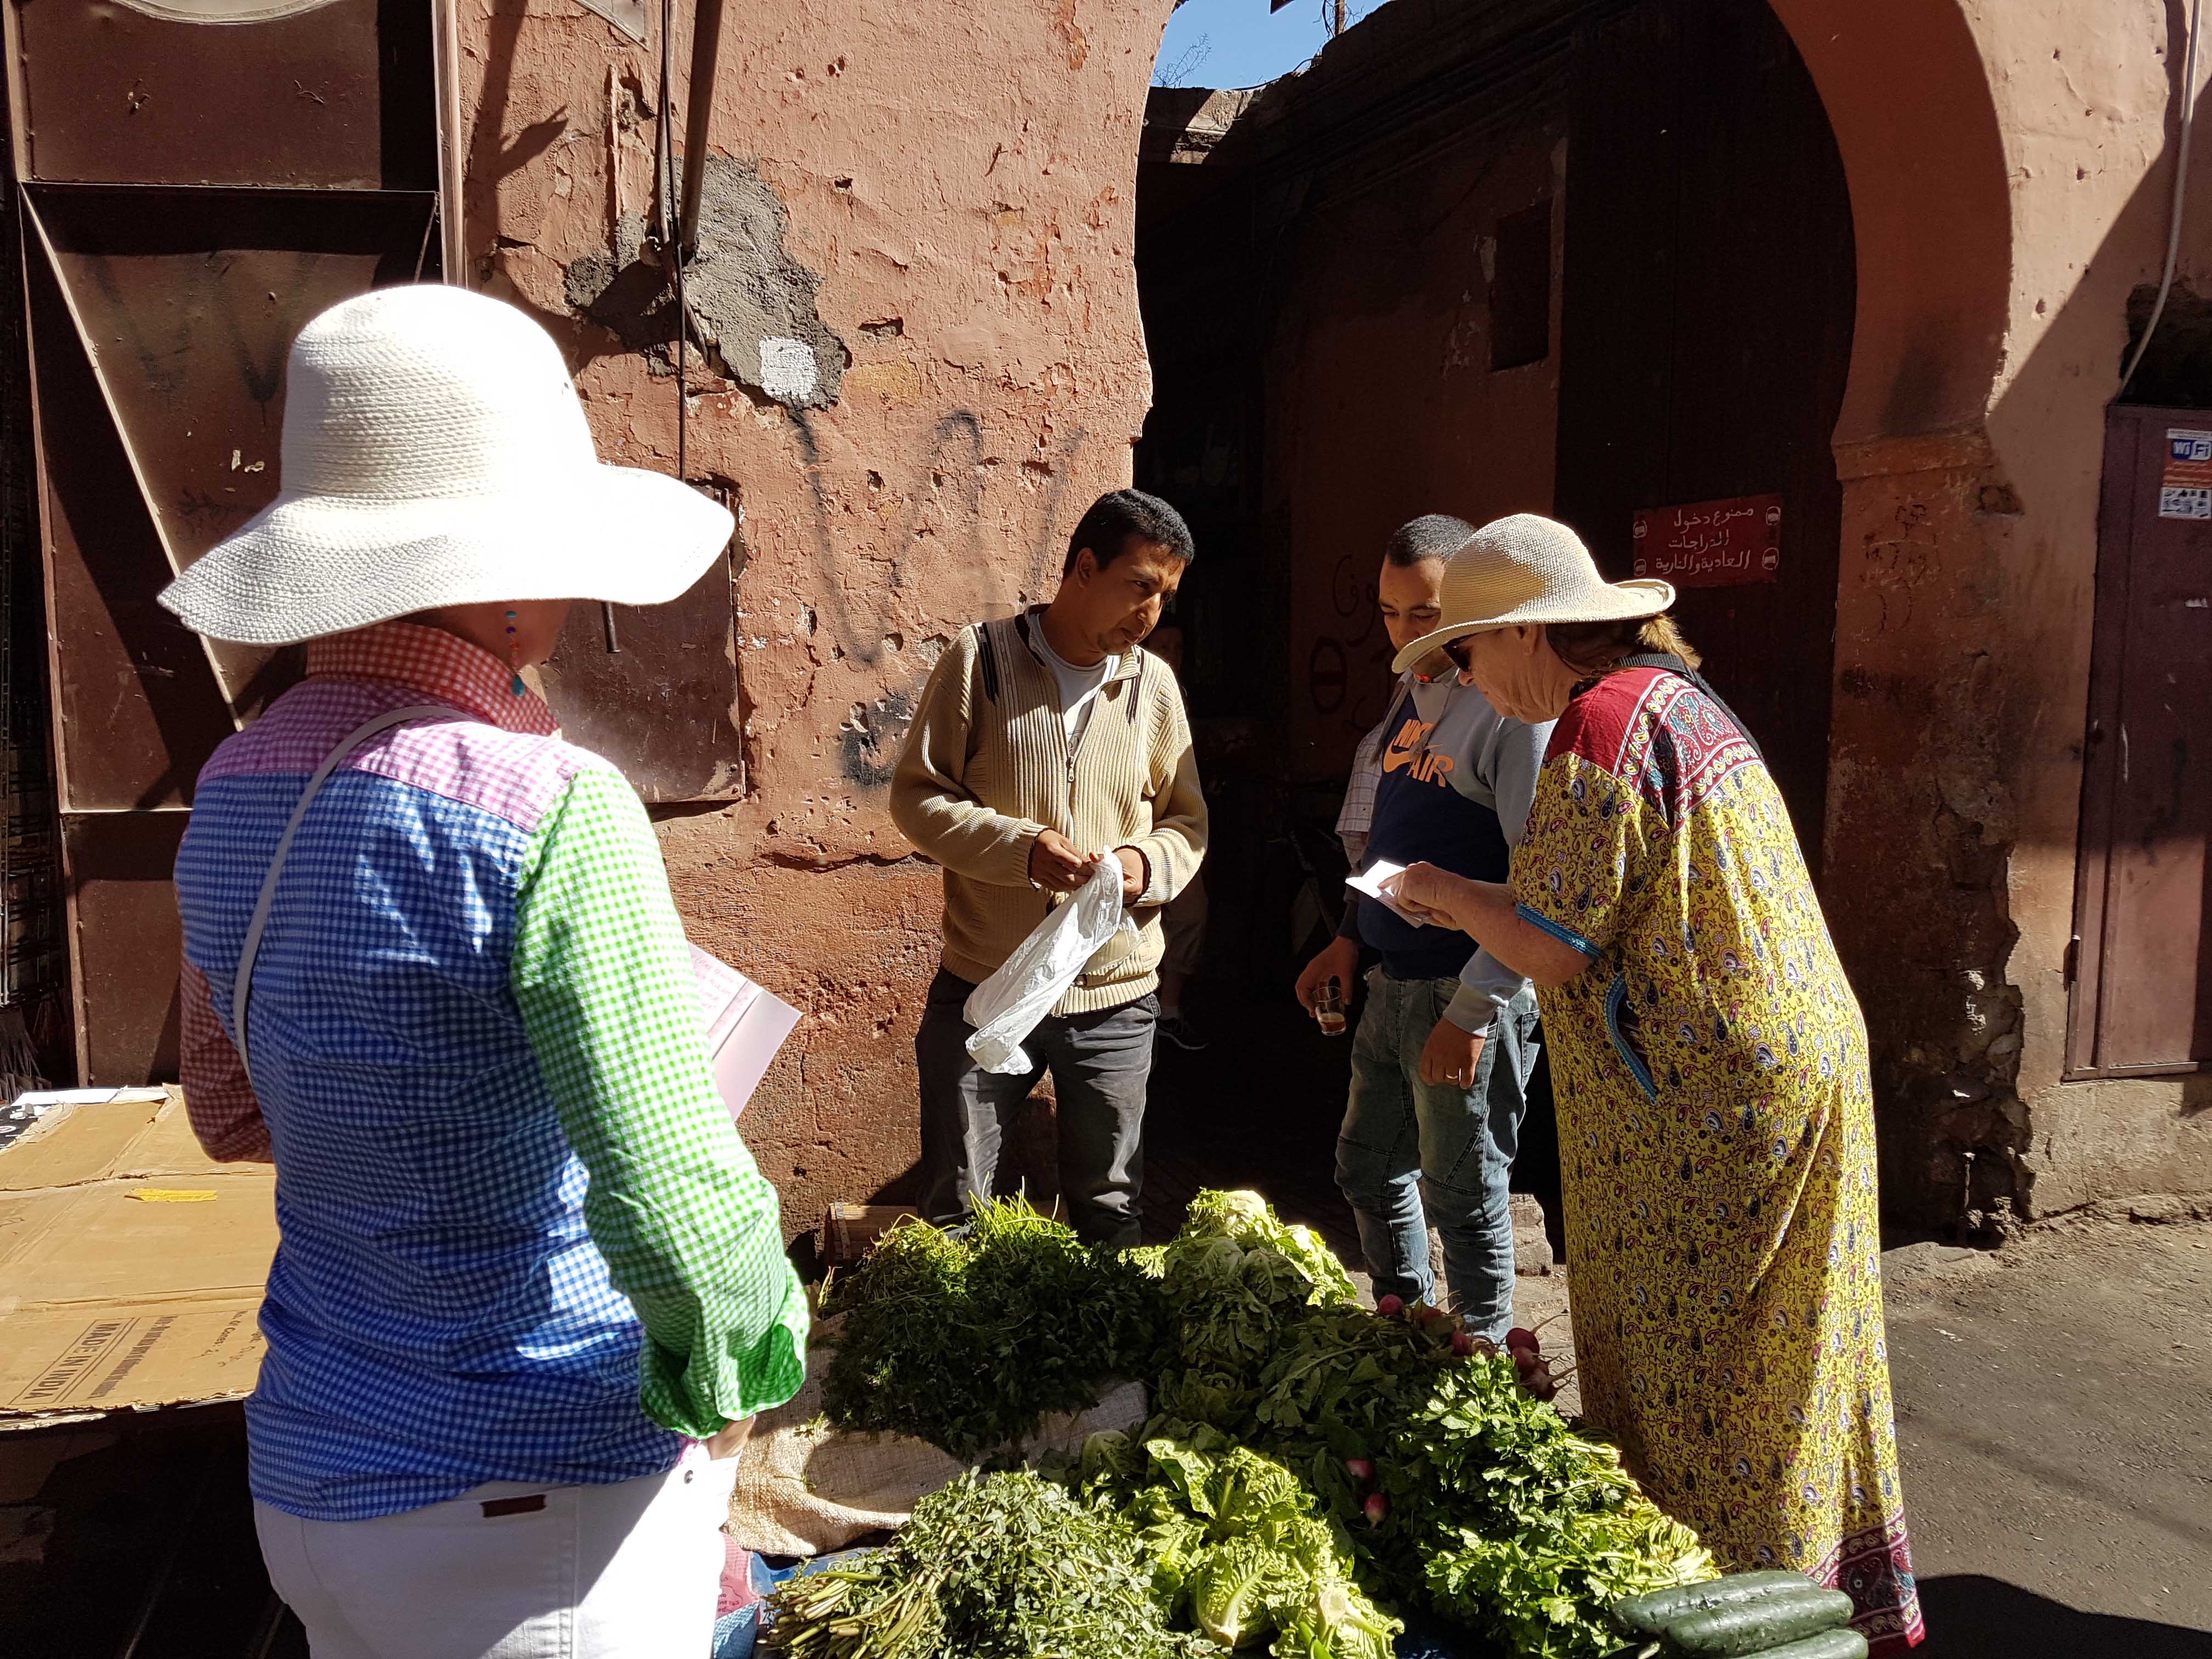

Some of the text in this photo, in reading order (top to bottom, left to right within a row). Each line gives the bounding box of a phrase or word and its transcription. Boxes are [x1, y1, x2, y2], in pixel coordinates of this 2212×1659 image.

[1673, 507, 1754, 534] ممنوع دخول
[1668, 528, 1730, 555] الدراجات
[1655, 549, 1751, 575] العادية والنارية
[1406, 753, 1455, 788] AIR
[22, 1323, 121, 1400] MADE IN INDIA
